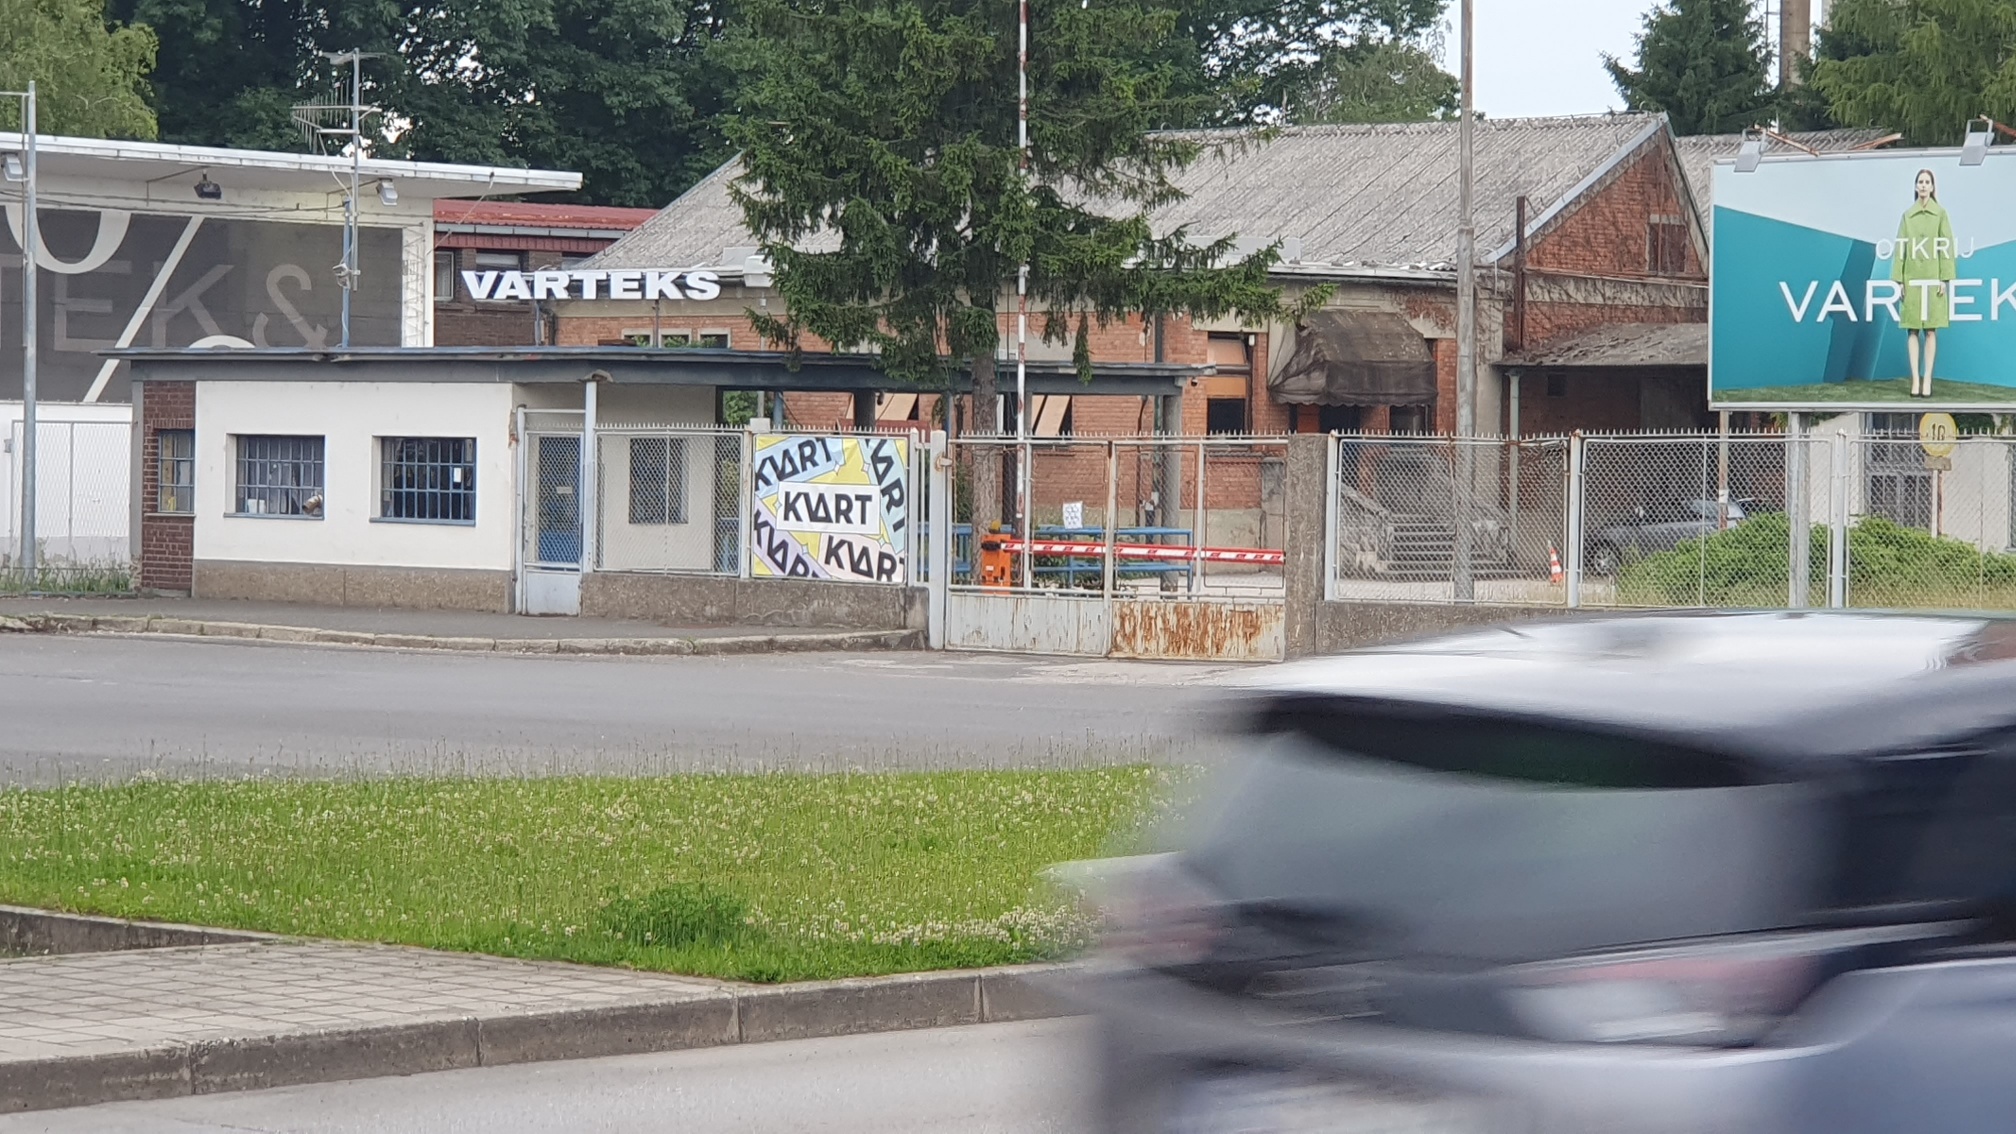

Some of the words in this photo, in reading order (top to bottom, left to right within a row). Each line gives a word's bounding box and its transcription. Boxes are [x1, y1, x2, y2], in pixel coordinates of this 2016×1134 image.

[1875, 236, 1975, 260] OTKRIJ
[461, 270, 721, 300] VARTEKS
[1778, 278, 2016, 323] VARTEK
[783, 491, 873, 525] KVART
[824, 535, 905, 582] KVAR
